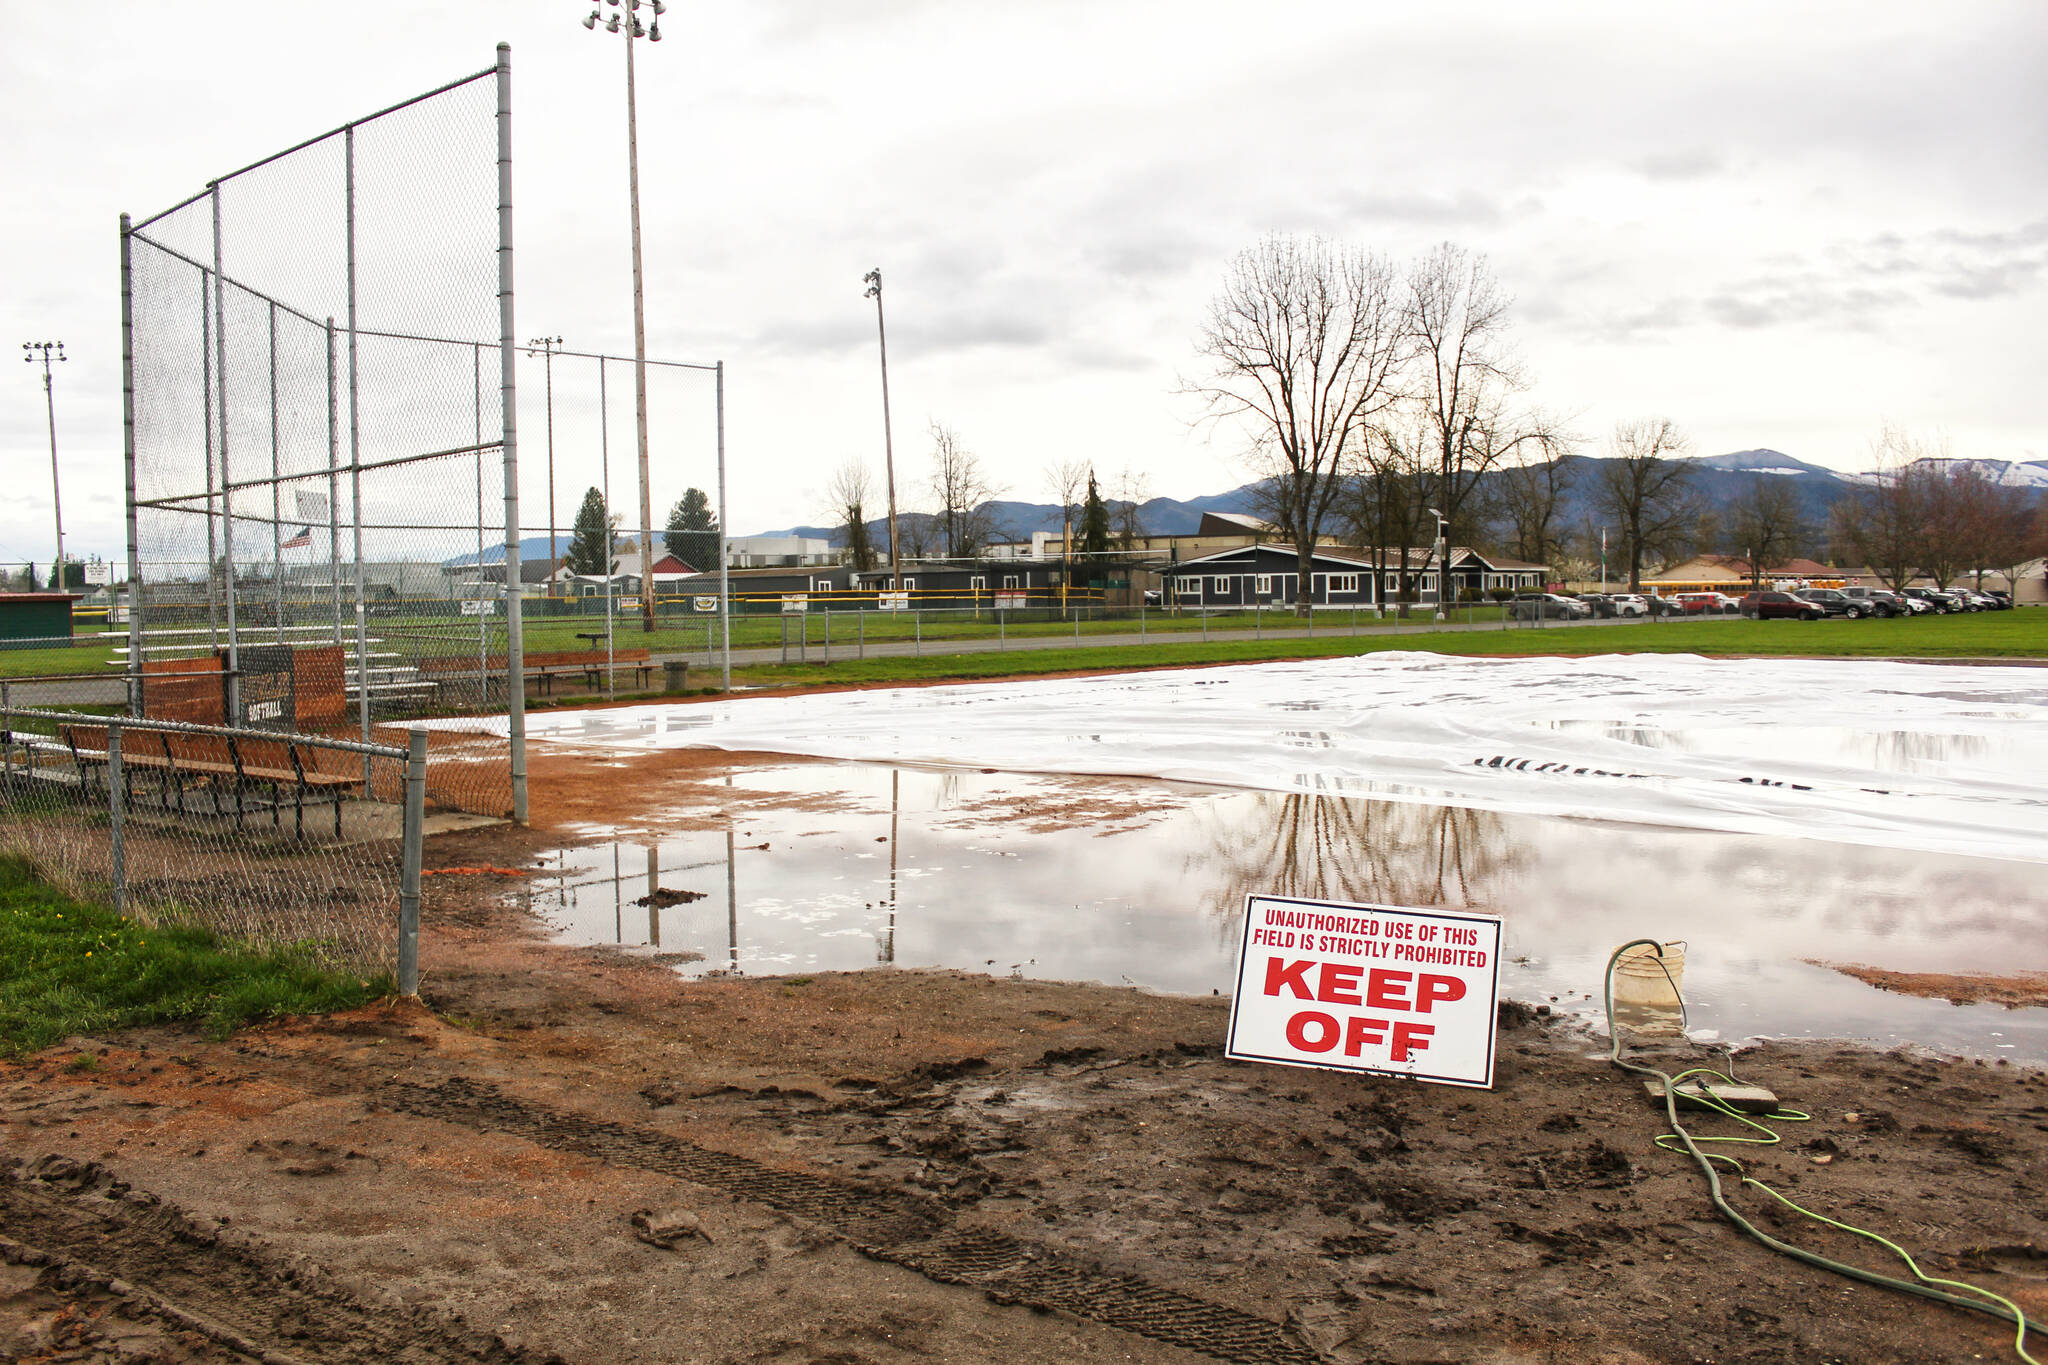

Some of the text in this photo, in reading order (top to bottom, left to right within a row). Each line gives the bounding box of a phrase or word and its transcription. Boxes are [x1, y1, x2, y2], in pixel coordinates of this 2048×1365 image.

[1254, 928, 1487, 968] FIELD IS STRICTLY PROHIBITED
[1265, 909, 1478, 946] UNAUTHORIZED USE OF THIS
[1264, 957, 1467, 1014] KEEP
[1286, 1011, 1435, 1062] OFF
